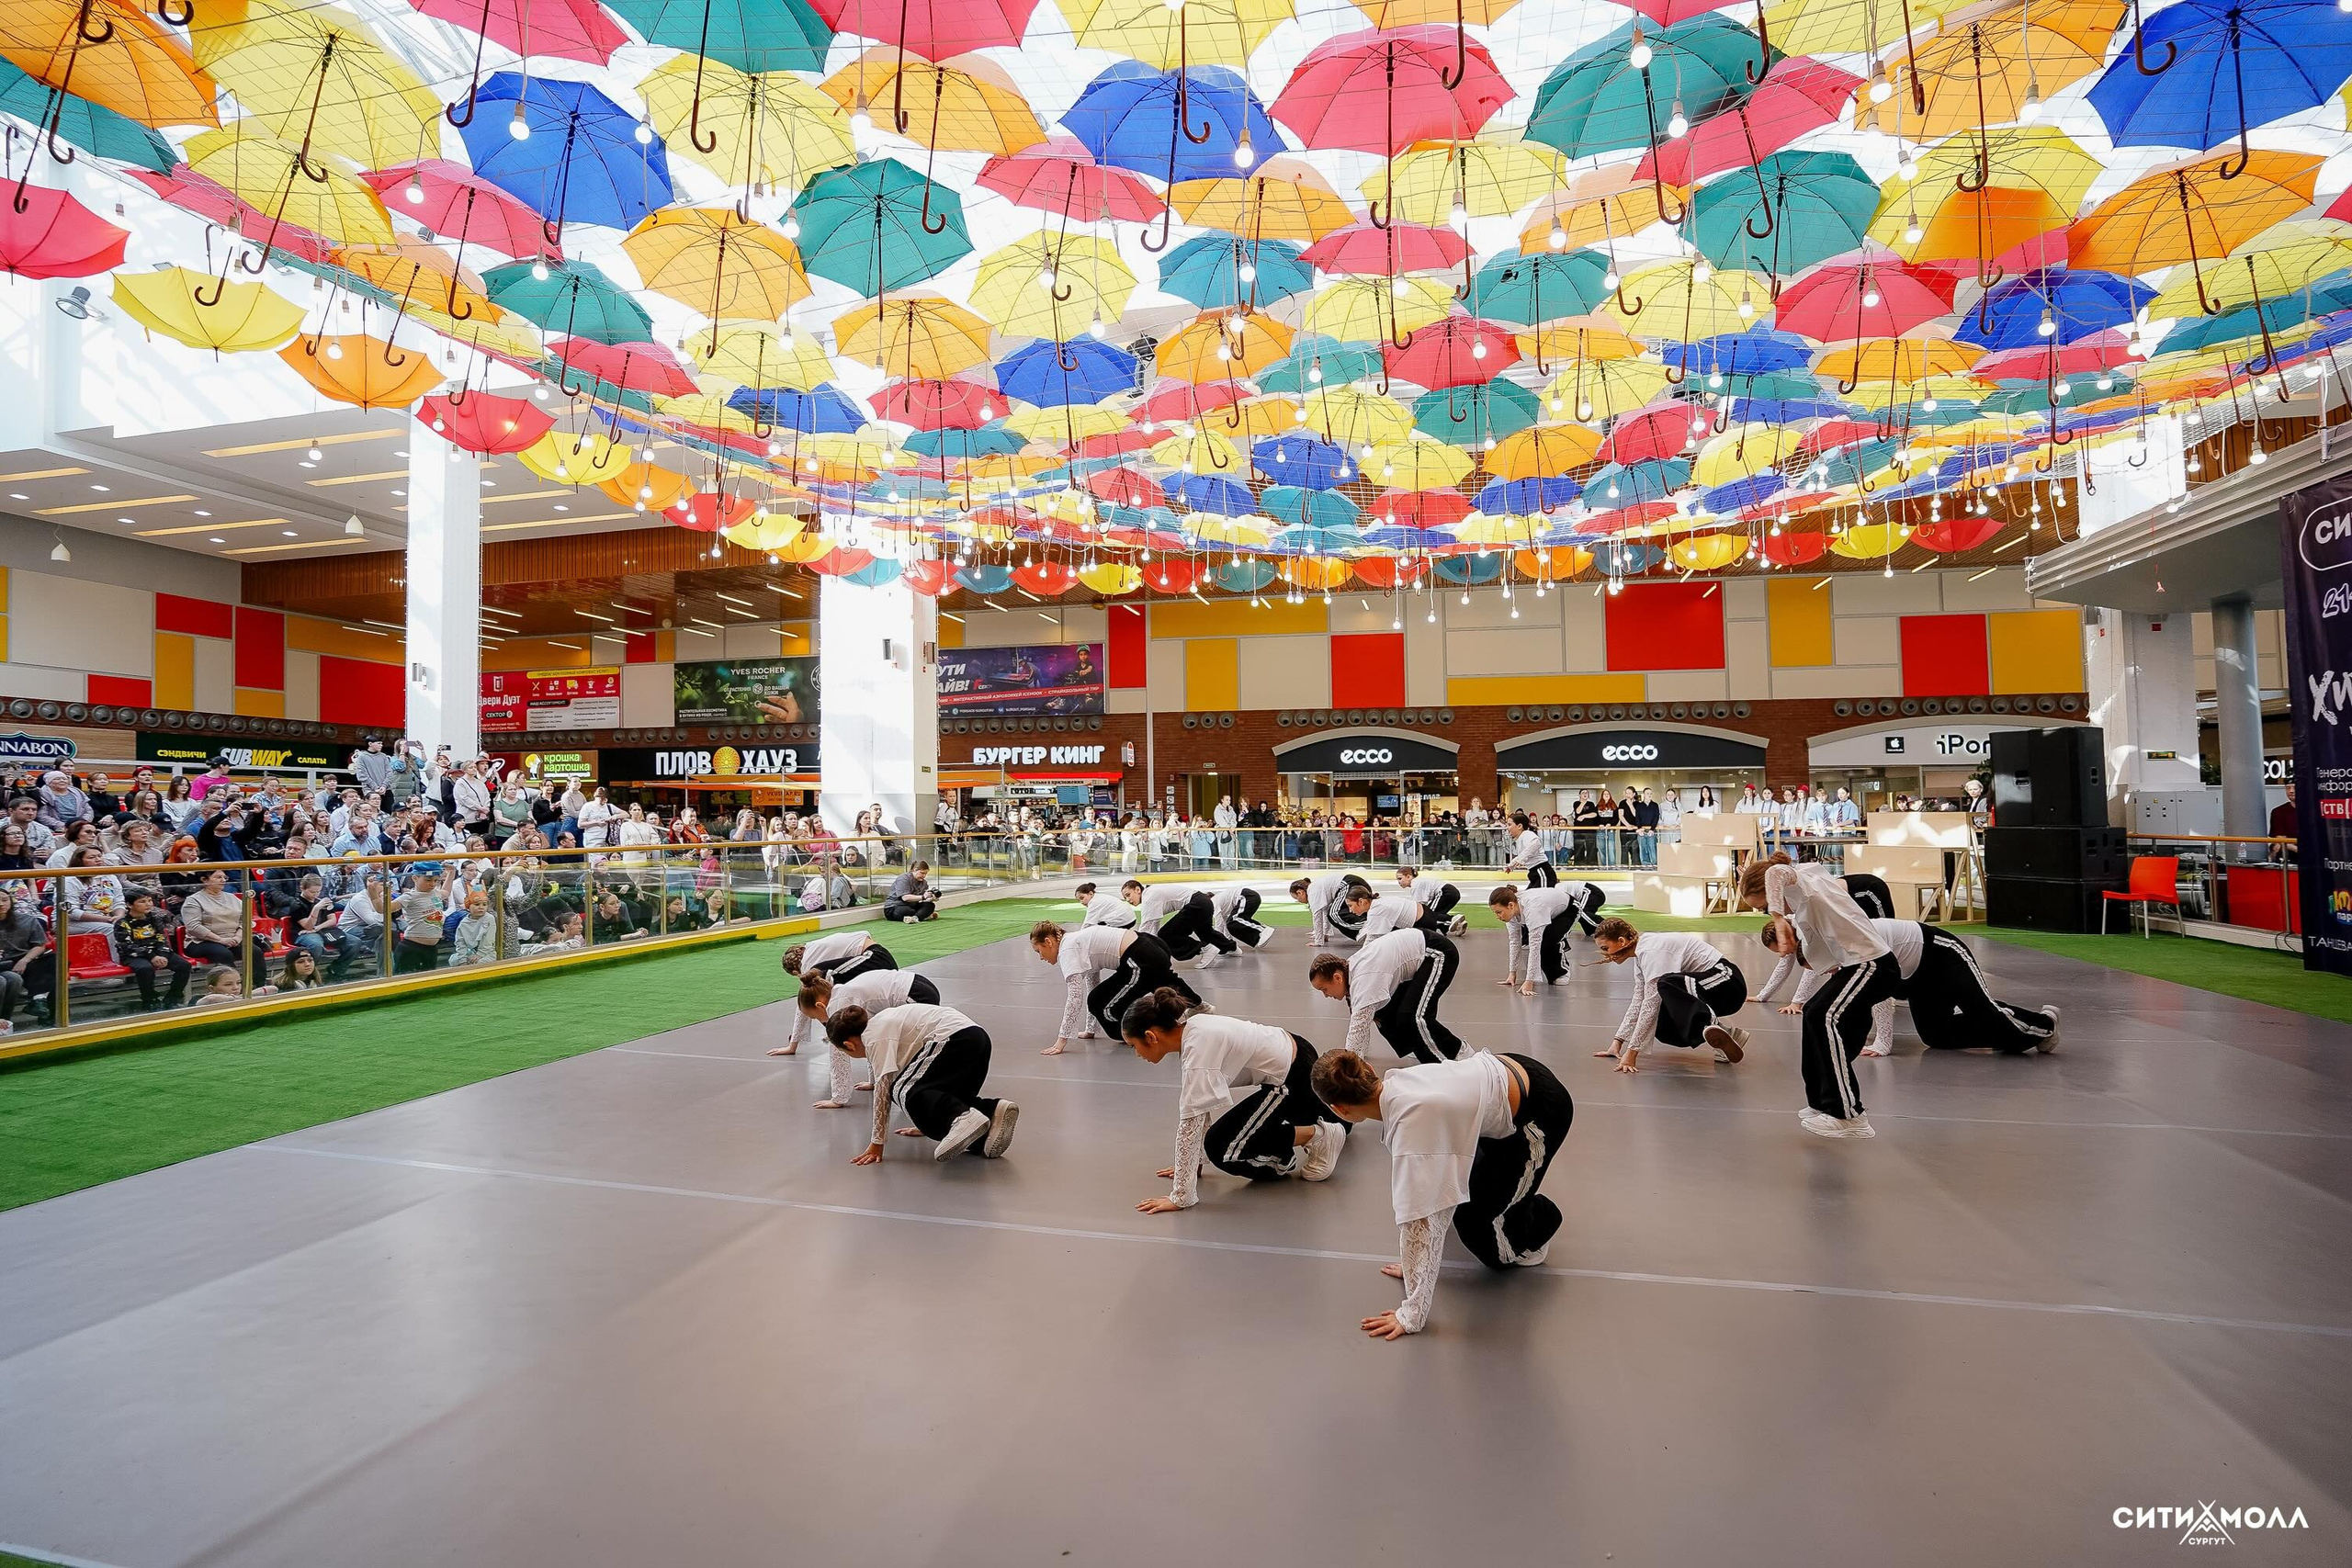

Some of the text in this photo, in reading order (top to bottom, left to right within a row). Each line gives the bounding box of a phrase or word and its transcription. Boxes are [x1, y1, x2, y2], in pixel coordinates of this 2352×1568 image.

[2315, 512, 2352, 544] СИ
[753, 666, 786, 674] ROCHER
[503, 694, 521, 706] Дуэт
[156, 749, 207, 759] СЭНДВИЧИ
[220, 747, 293, 767] SUBWAY
[543, 753, 582, 764] крошка
[973, 745, 1047, 765] БУРГЕР
[1050, 745, 1105, 764] КИНГ
[1340, 748, 1393, 764] ecco
[1601, 744, 1658, 761] ecco
[297, 756, 327, 764] САЛАТЫ
[655, 749, 797, 775] ПЛОВ ХАУЗ
[543, 762, 592, 774] картошка
